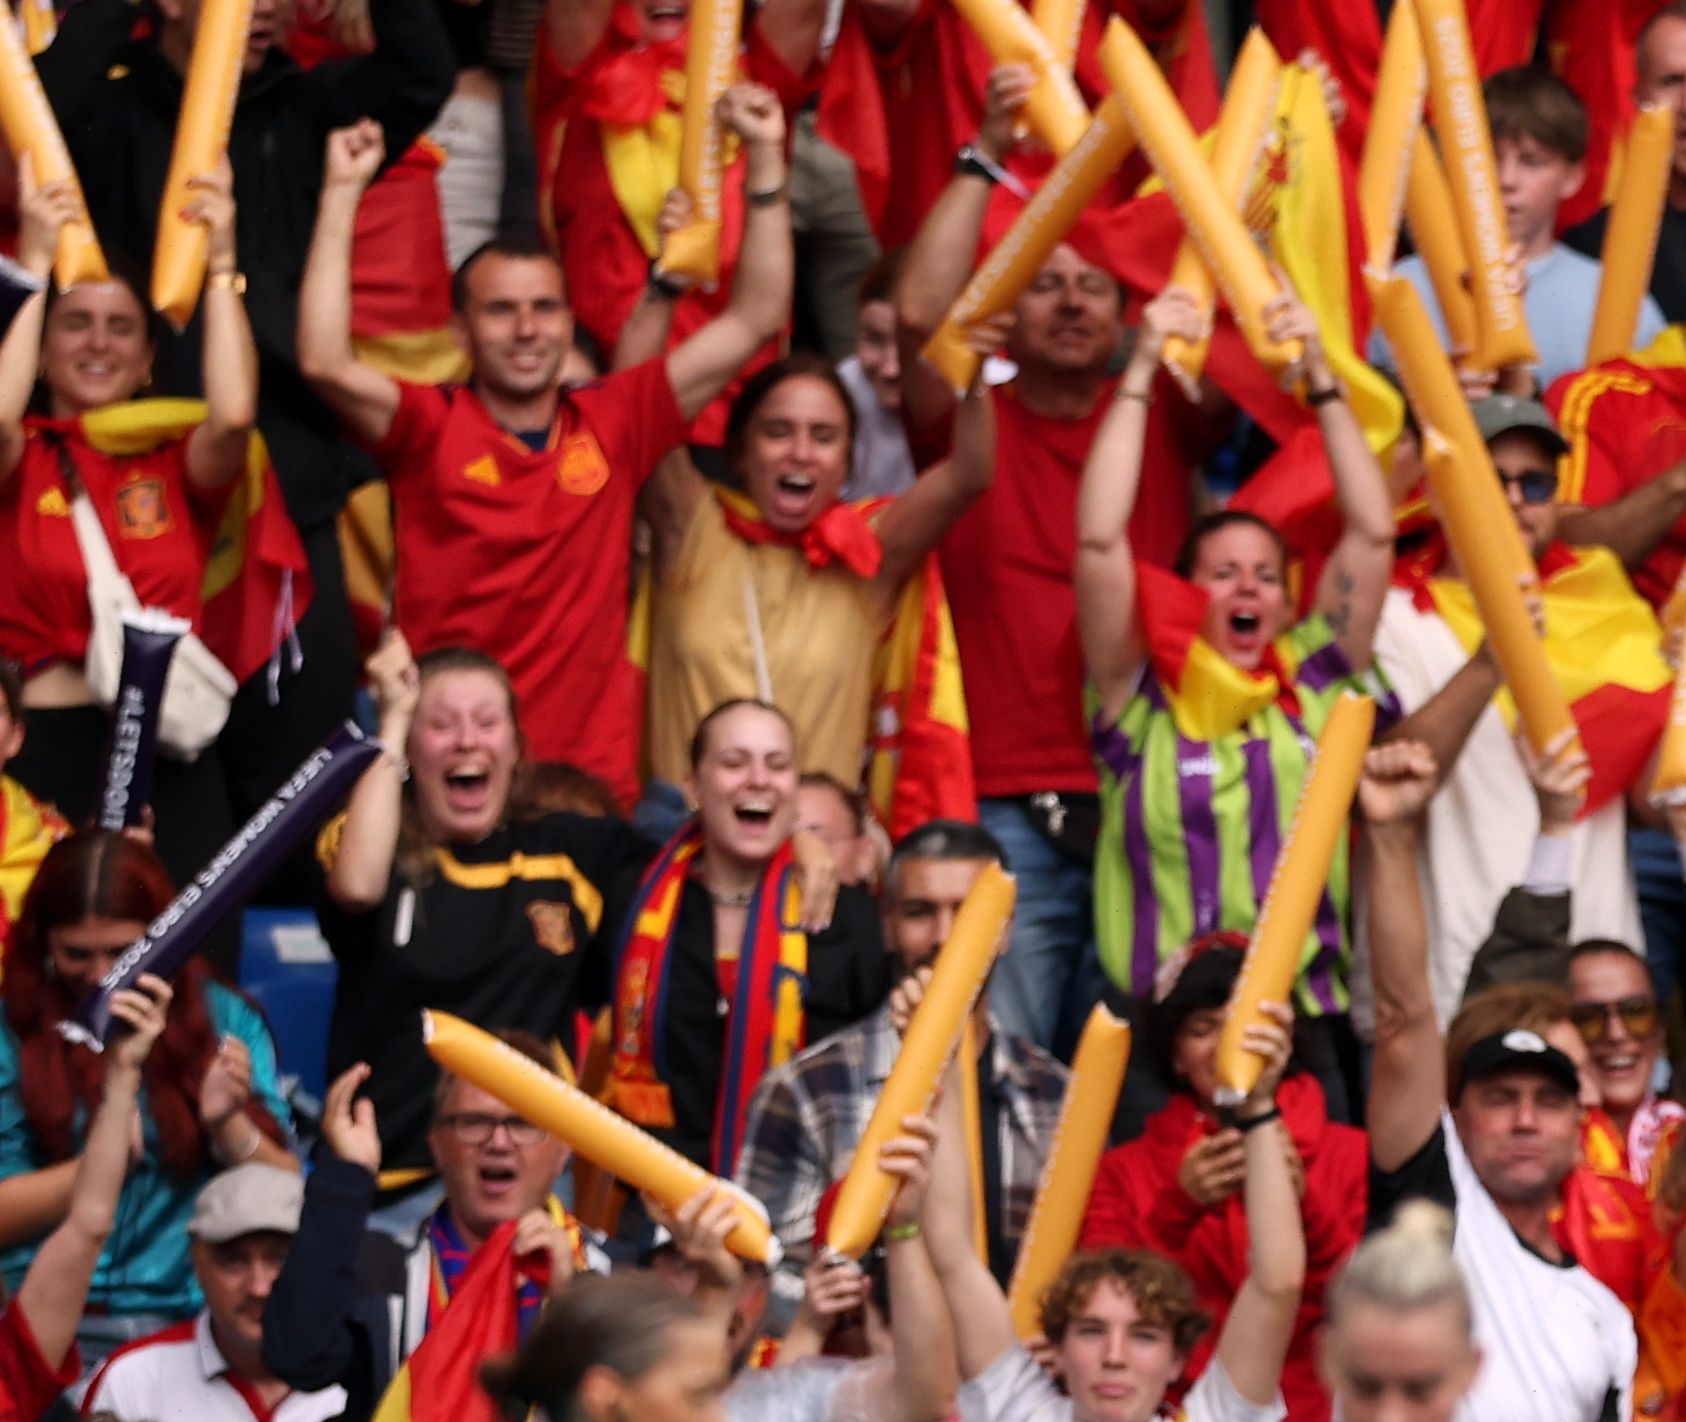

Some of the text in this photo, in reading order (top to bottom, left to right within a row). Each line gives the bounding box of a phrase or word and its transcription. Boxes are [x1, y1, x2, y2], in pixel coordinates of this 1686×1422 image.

[95, 743, 335, 994] UEFA WOMEN'S EURO 2025
